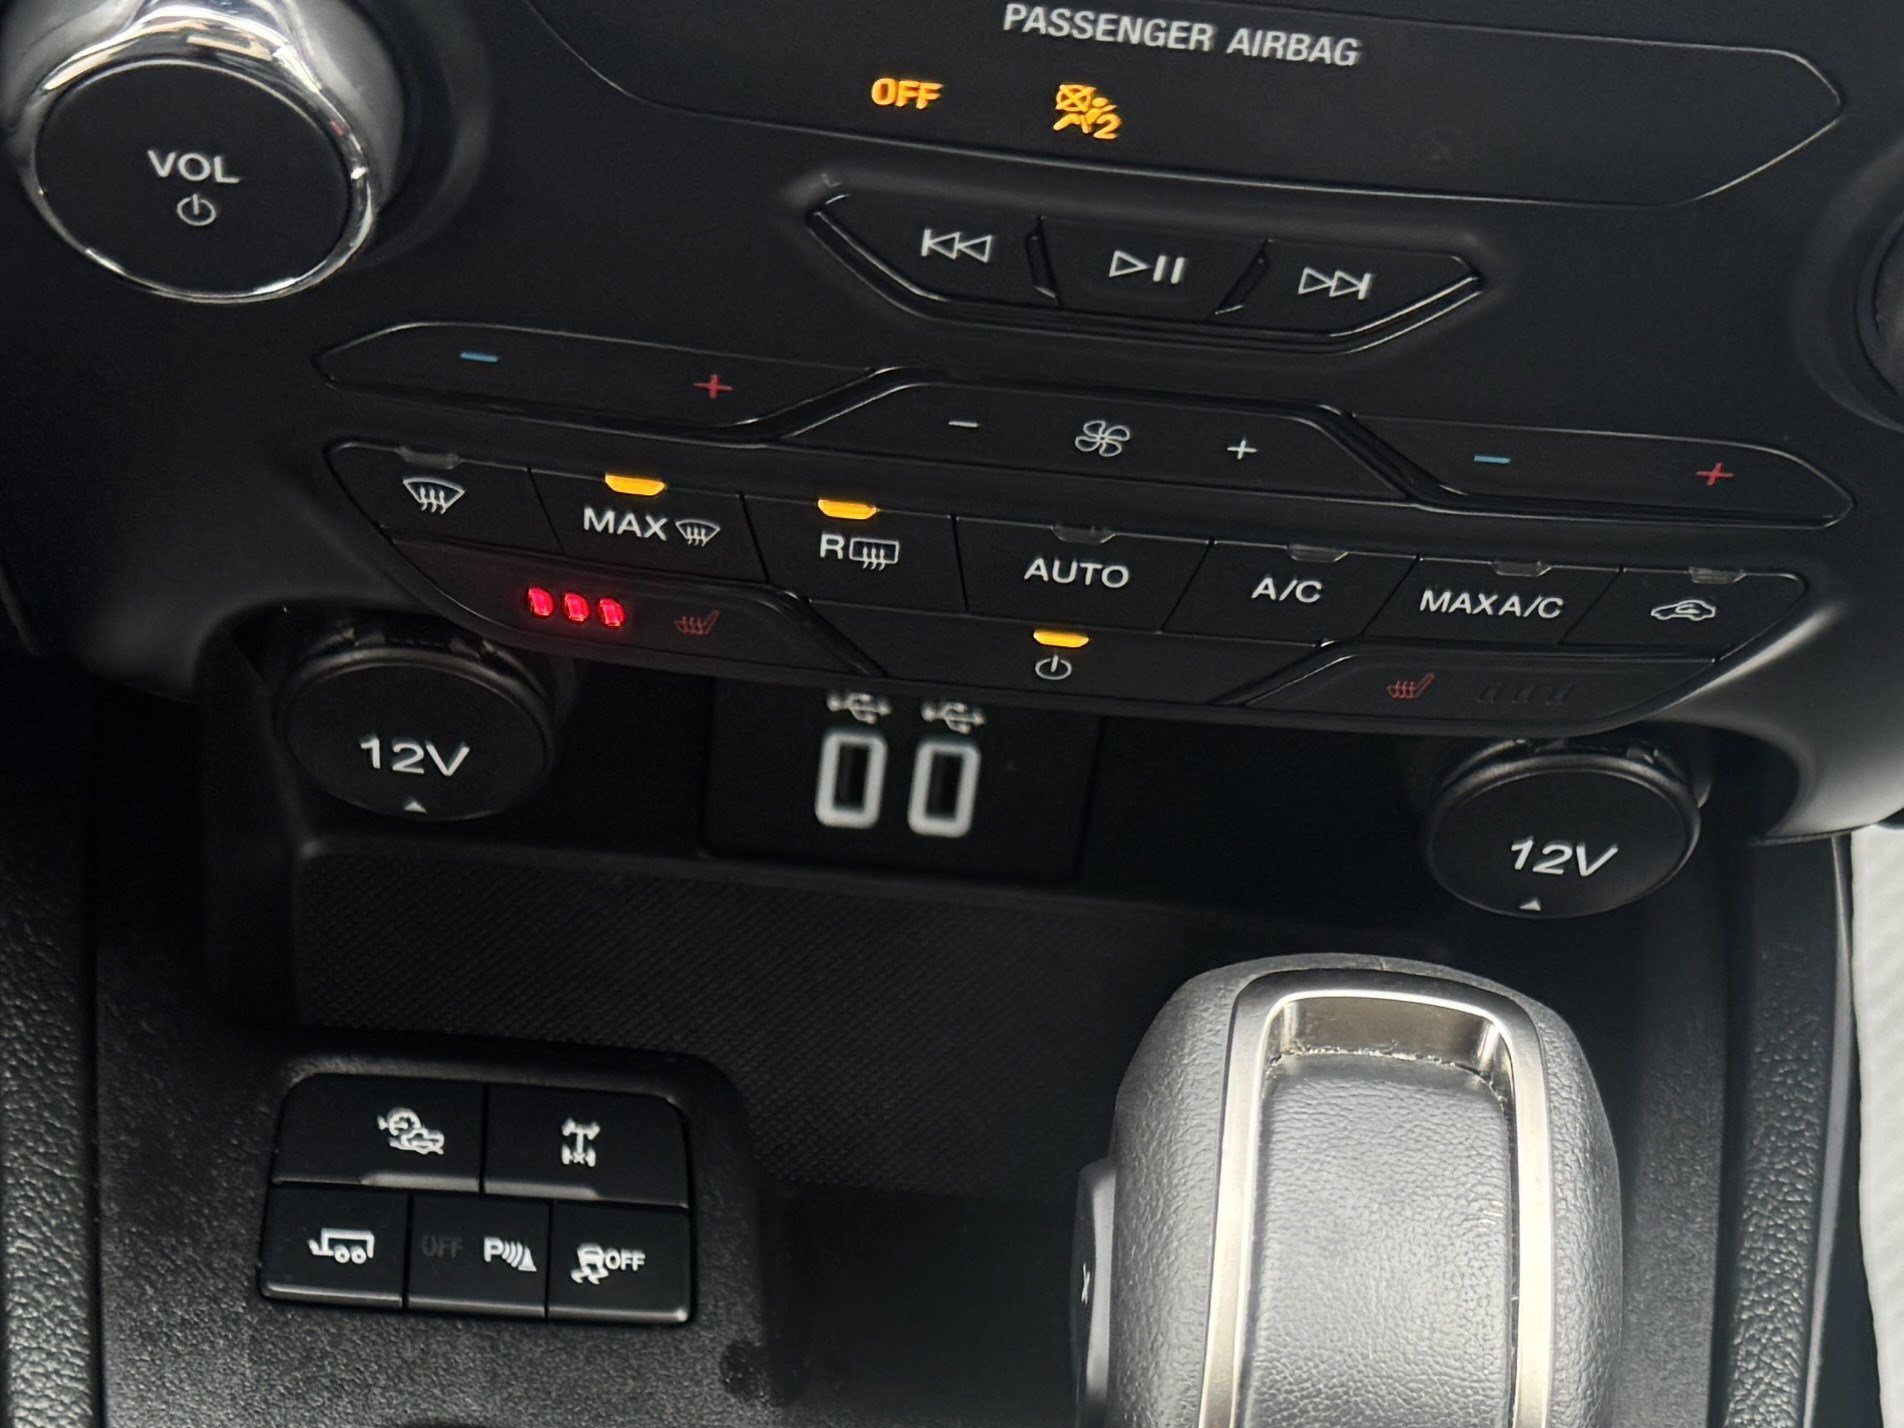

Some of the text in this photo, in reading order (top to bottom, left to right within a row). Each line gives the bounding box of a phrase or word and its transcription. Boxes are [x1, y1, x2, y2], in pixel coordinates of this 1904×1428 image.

[1003, 3, 1362, 67] PASSENGER AIRBAG
[870, 77, 943, 109] OFF
[147, 148, 242, 186] VOL
[583, 505, 668, 542] MAX
[819, 533, 844, 560] R
[1024, 555, 1130, 590] AUTO
[1251, 576, 1323, 606] A/C
[359, 733, 470, 779] 12V
[1510, 836, 1620, 878] 12V
[604, 1248, 646, 1272] OFF
